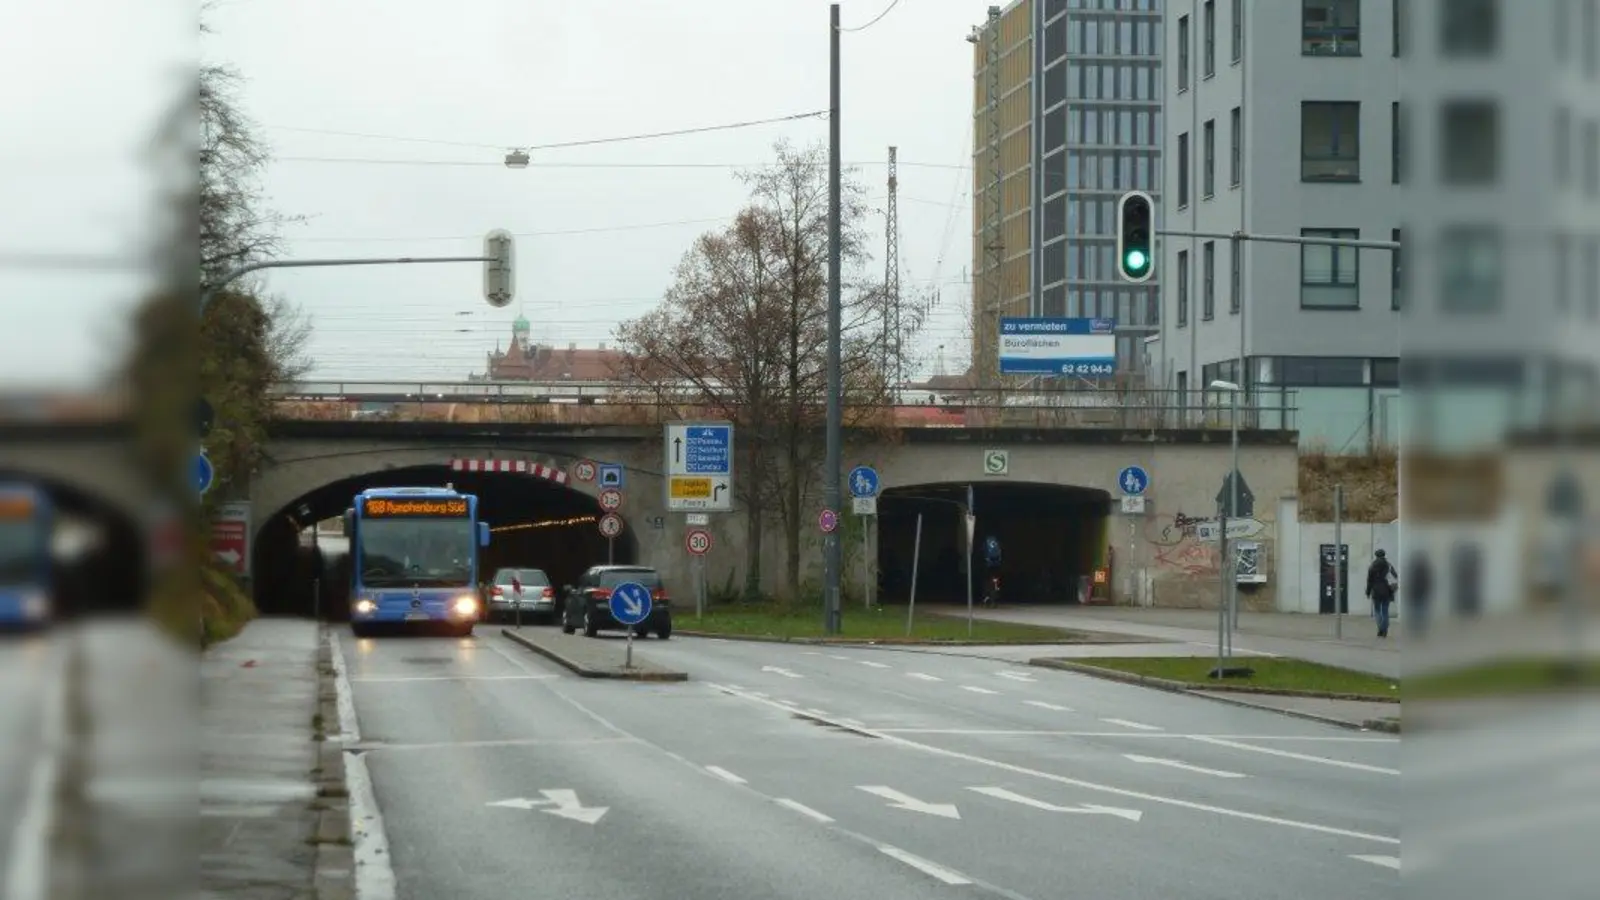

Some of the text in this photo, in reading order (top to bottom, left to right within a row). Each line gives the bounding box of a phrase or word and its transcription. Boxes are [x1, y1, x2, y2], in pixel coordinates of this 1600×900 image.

[1003, 322, 1067, 331] zu vermieten
[1062, 364, 1074, 373] 62
[1076, 364, 1088, 373] 42
[447, 499, 466, 514] Süd
[692, 535, 706, 549] 30
